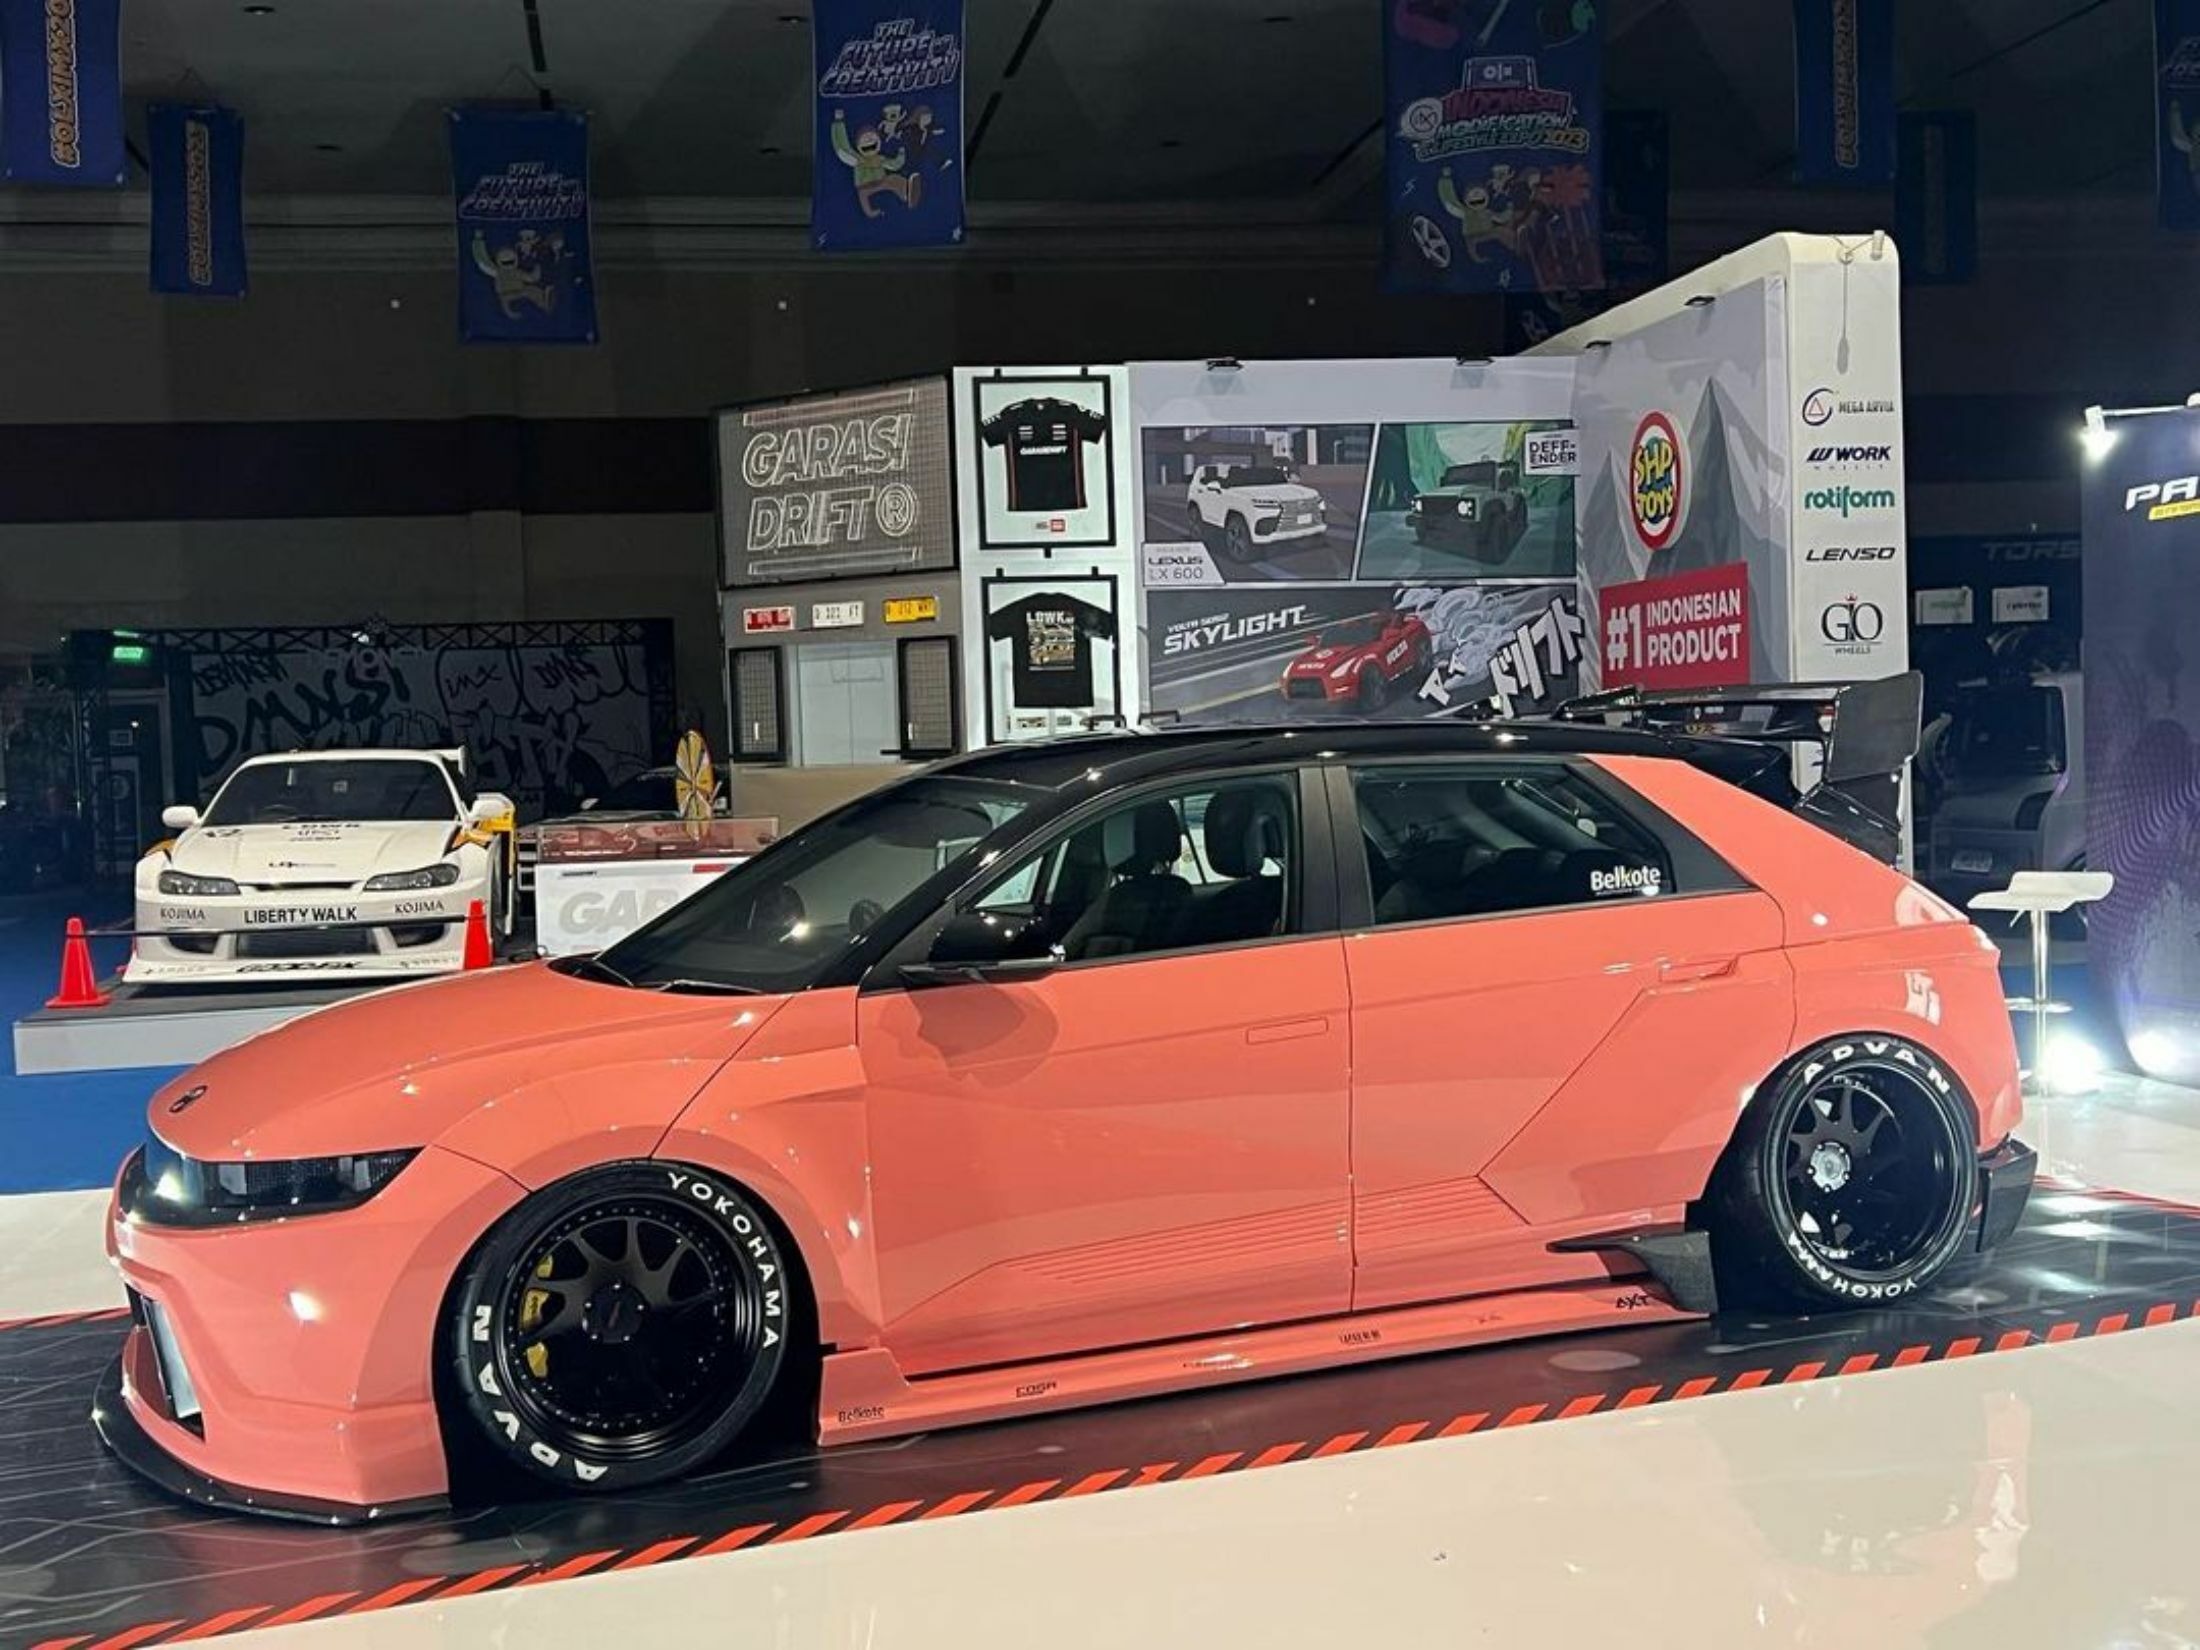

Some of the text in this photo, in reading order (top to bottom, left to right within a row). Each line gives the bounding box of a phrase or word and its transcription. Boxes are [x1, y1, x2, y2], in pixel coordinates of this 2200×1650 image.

[742, 412, 913, 487] GARASI
[1836, 446, 1891, 461] WORK
[1804, 485, 1895, 518] rotiform
[1173, 566, 1204, 579] 600
[1806, 547, 1895, 561] LENSO
[1164, 604, 1307, 655] SKYLIGHT
[1607, 588, 1741, 671] #1 INDONESIAN
[1647, 623, 1742, 668] PRODUCT
[1591, 865, 1661, 891] Belkote
[244, 903, 358, 923] LIBERTY WALK
[394, 900, 445, 915] KOJIMA
[1804, 1041, 1950, 1094] ADVAN
[668, 1172, 781, 1349] YOKOHAMA
[1788, 1230, 1917, 1299] YOKOHAMA
[472, 1304, 608, 1482] ADVAN
